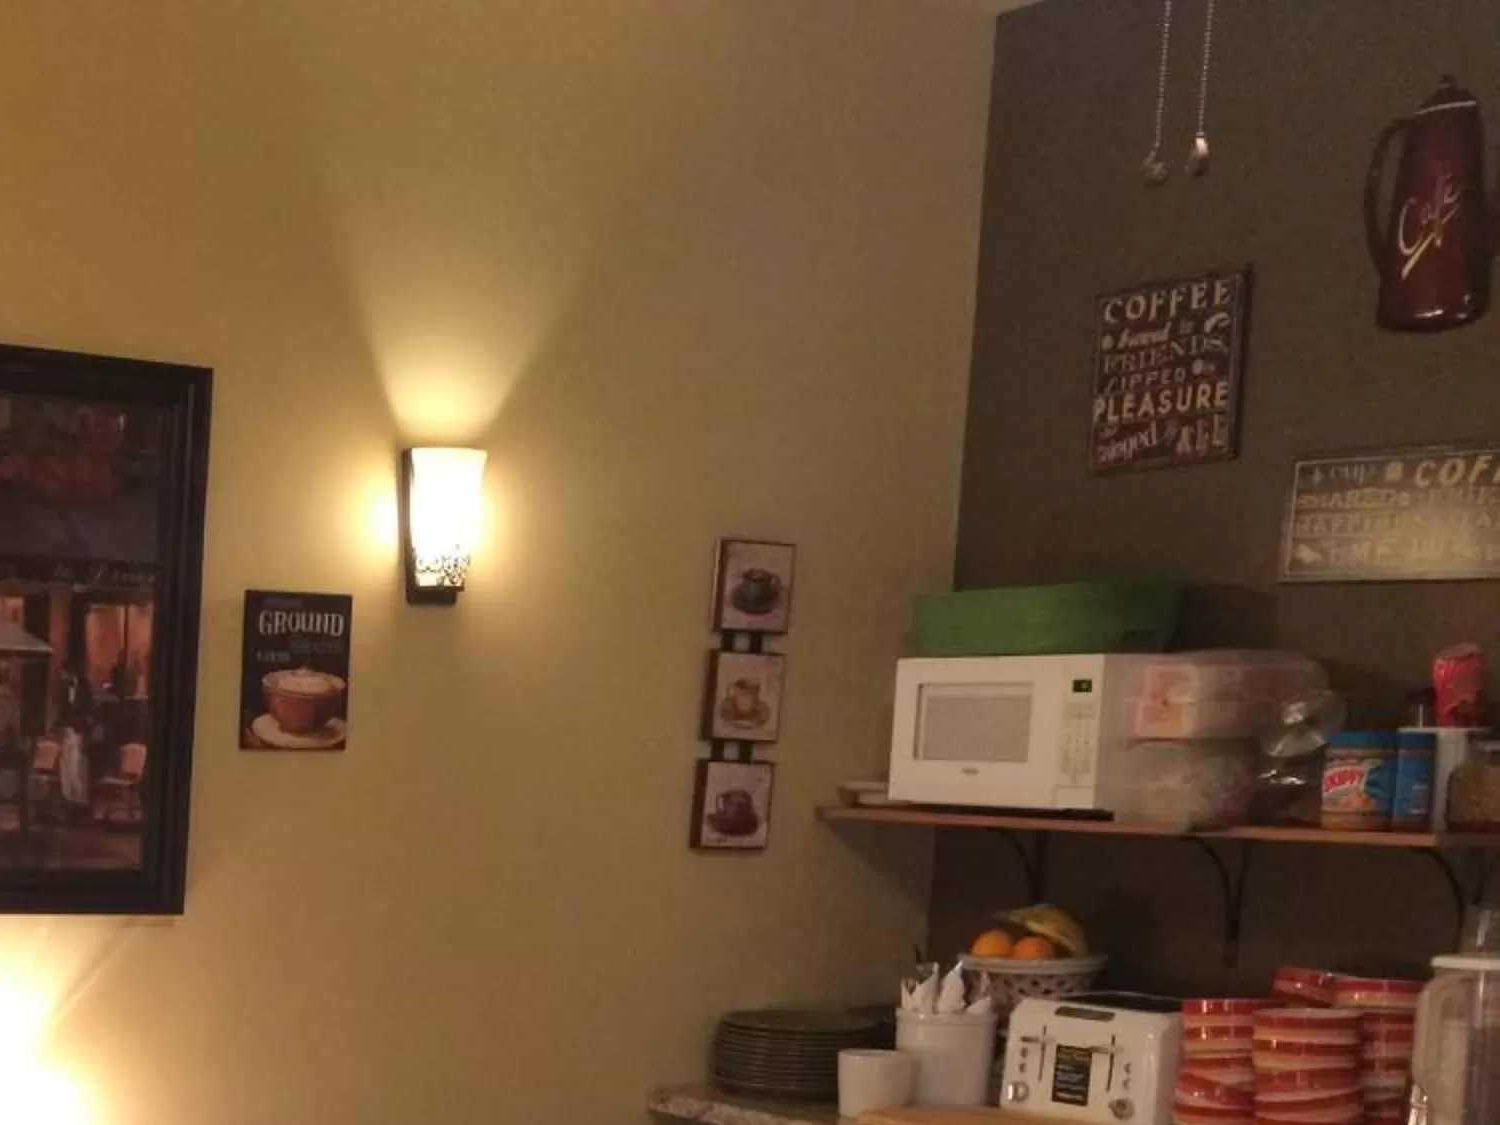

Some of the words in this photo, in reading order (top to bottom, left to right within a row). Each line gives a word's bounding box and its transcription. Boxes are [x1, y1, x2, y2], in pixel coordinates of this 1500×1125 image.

[1103, 279, 1232, 324] COFFEE
[1093, 380, 1229, 423] PLEASURE
[258, 609, 345, 637] GROUND
